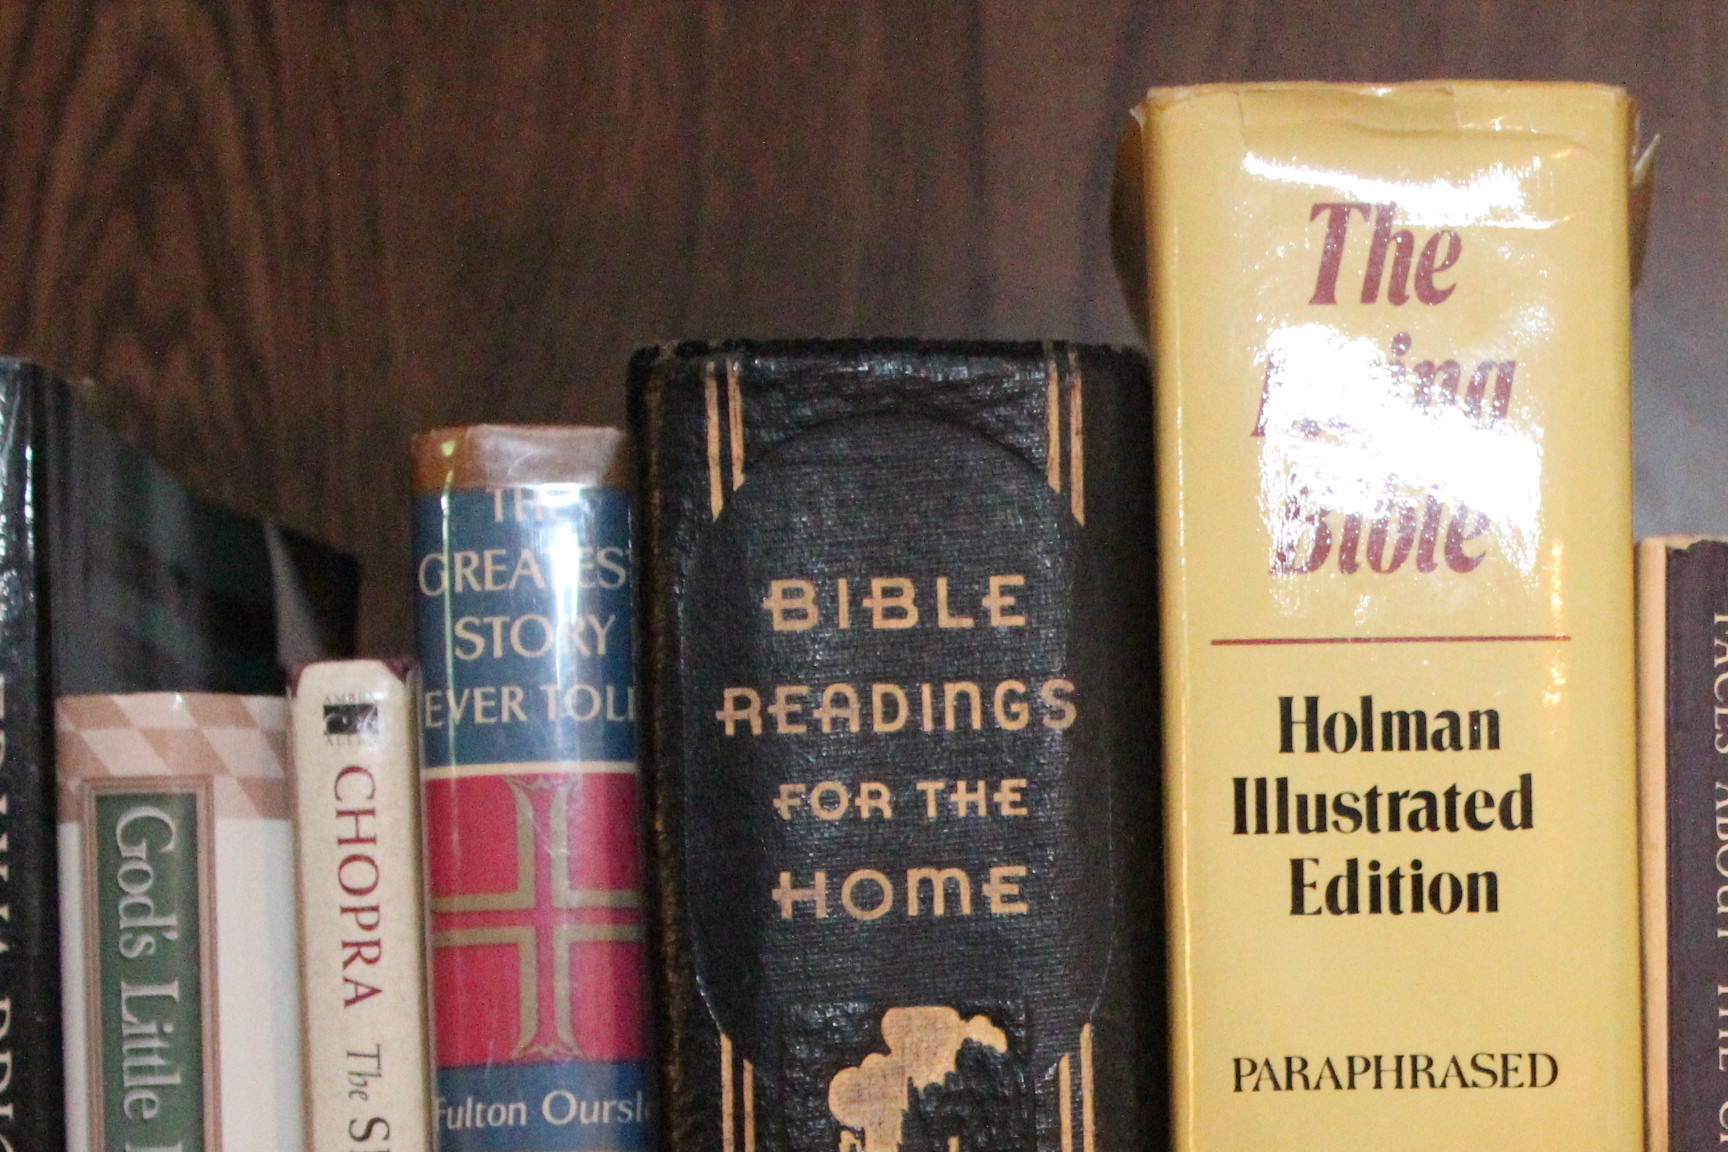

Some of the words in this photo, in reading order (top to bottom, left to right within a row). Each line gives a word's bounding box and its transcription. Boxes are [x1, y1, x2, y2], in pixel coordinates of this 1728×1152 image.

[1308, 200, 1462, 307] The
[763, 574, 1027, 632] BIBLE
[454, 614, 616, 660] STORY
[424, 686, 528, 728] EVER
[715, 678, 1077, 736] READINGS
[1278, 695, 1501, 754] Holman
[773, 781, 894, 820] FOR
[916, 778, 1029, 818] THE
[1232, 773, 1534, 835] Illustrated
[113, 806, 178, 961] God's
[334, 764, 384, 1009] CHOPRA
[771, 865, 1029, 921] HOME
[1288, 857, 1500, 916] Edition
[120, 981, 183, 1120] Little
[345, 1044, 382, 1103] The
[1232, 1052, 1559, 1092] PARAPHRASED
